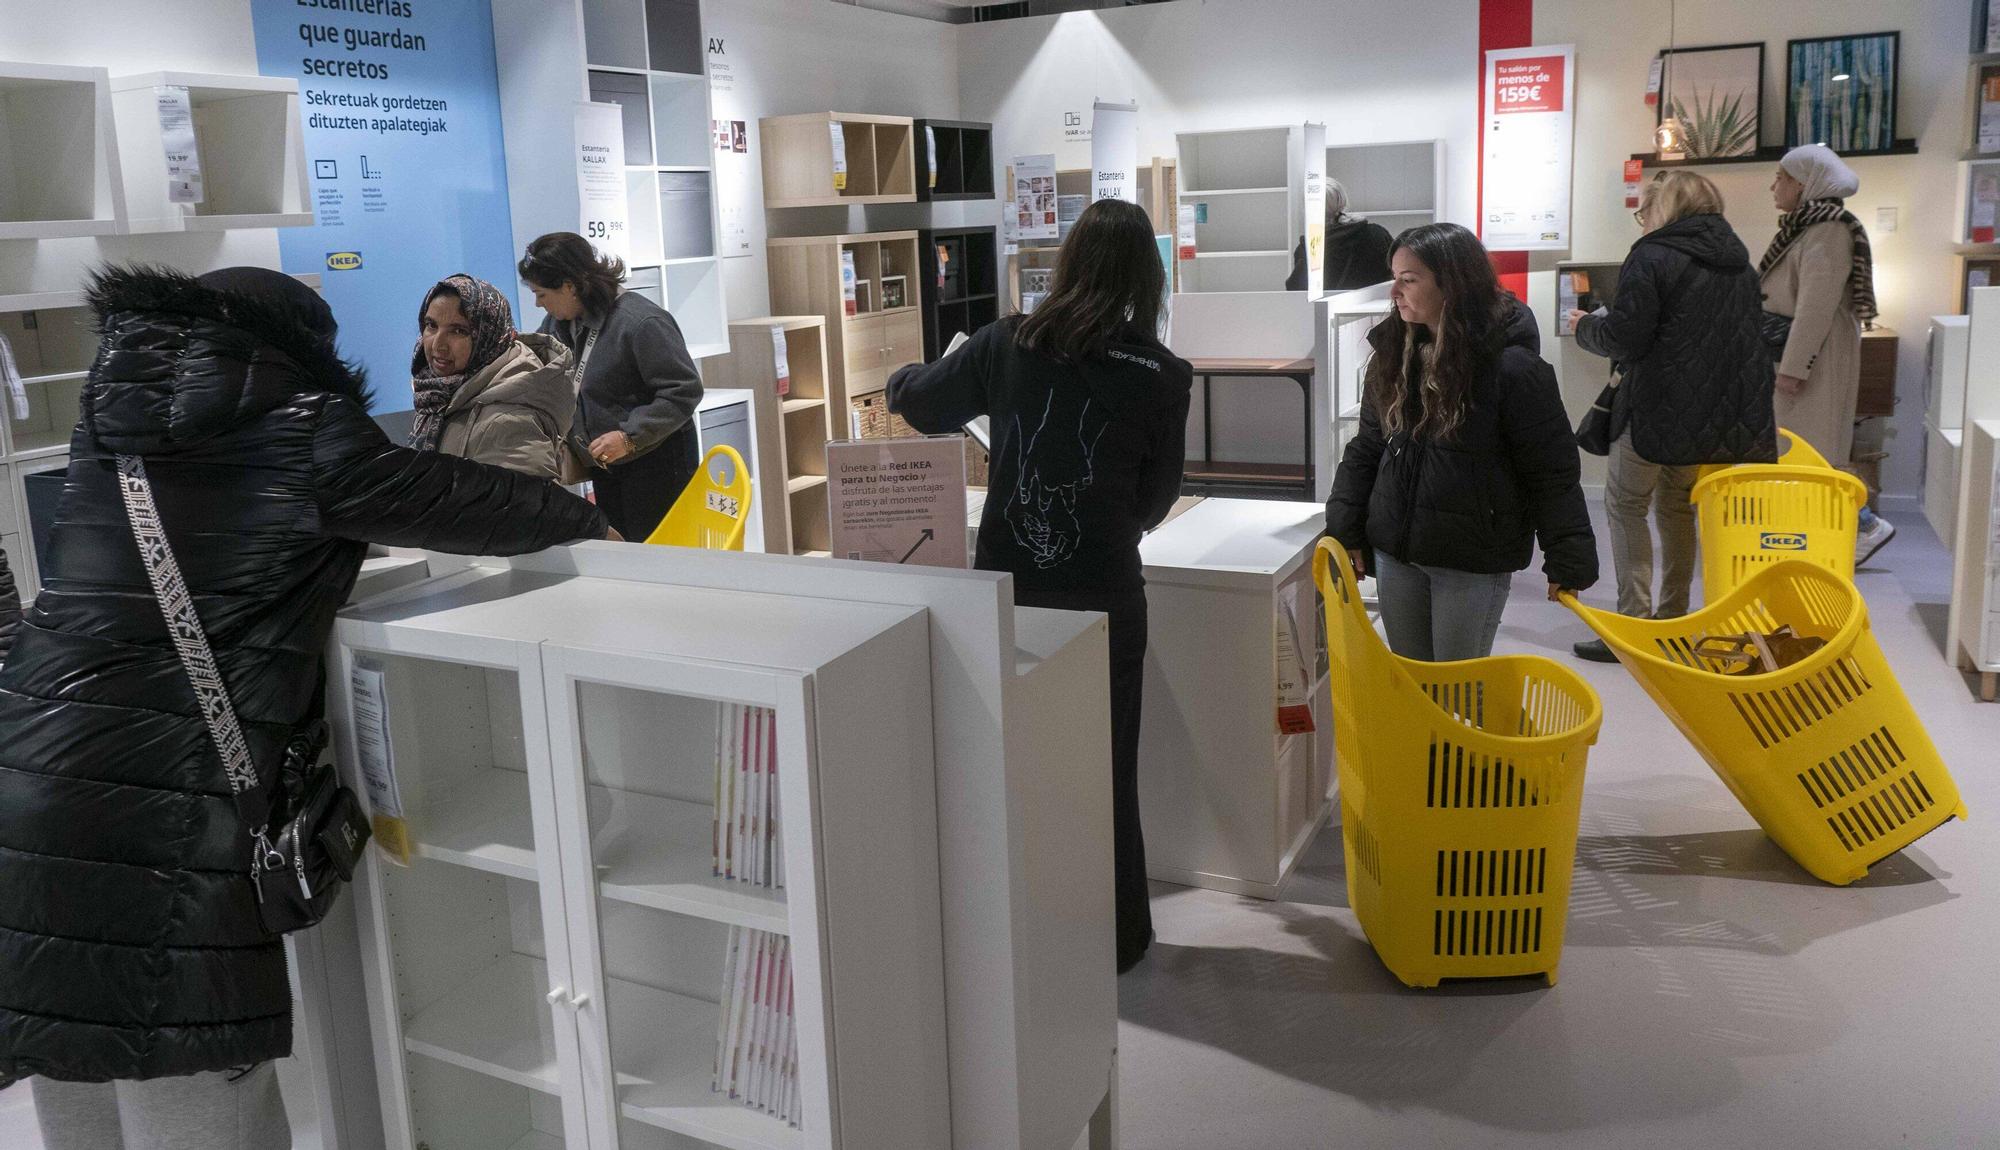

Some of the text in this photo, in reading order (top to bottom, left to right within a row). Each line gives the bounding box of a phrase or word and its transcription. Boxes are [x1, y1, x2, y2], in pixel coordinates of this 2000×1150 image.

[296, 0, 412, 18] stanteras
[299, 23, 426, 50] que guardan
[302, 57, 388, 80] secretos
[1508, 65, 1528, 73] salón
[1498, 72, 1550, 84] menos de
[306, 90, 448, 112] Sekretuak gordetzen
[1498, 85, 1542, 103] 159€
[309, 113, 448, 136] dituzten apalategiak
[582, 155, 607, 165] KALLAX
[1098, 186, 1121, 198] KALLAX
[588, 221, 624, 240] 59,99€
[840, 462, 870, 473] Únete
[879, 463, 887, 471] la
[889, 461, 907, 471] Red
[910, 461, 932, 469] IKEA
[841, 473, 927, 486] para tu Negocio y
[842, 483, 945, 496] disfruta de las ventajas
[842, 495, 937, 509] ¡gratis y al momento!
